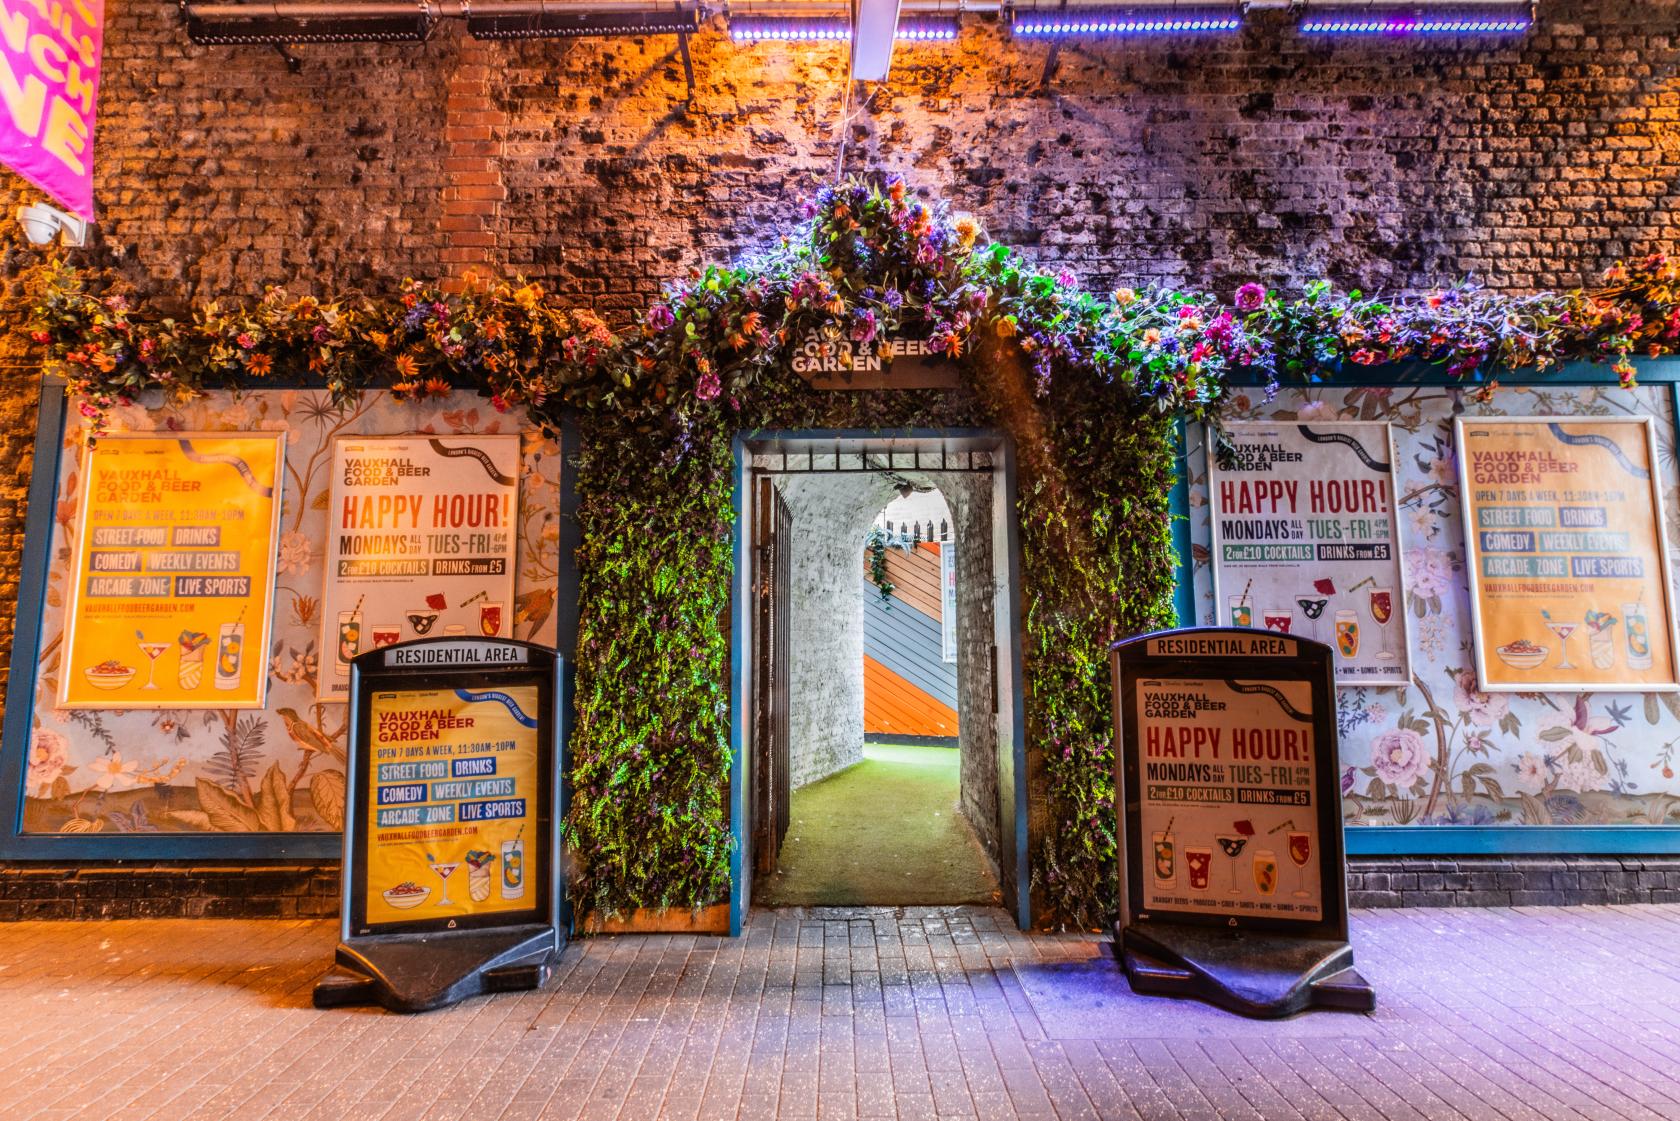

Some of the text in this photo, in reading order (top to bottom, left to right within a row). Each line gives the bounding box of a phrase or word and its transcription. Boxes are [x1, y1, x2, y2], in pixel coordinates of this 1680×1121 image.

[858, 341, 872, 356] &
[878, 340, 933, 356] EER
[791, 356, 881, 372] GAREN
[1230, 443, 1286, 453] UXHALL
[345, 458, 414, 468] VAUXHALL
[1258, 453, 1267, 462] &
[1270, 453, 1303, 462] BEER
[1473, 451, 1557, 462] VAUXHALL
[99, 470, 182, 480] VAUXHALL
[344, 467, 431, 477] FOOD & BEER
[1474, 463, 1578, 473] FOOD & BEER
[97, 481, 201, 492] FOOD & BEER
[343, 477, 399, 486] GARDEN
[1475, 474, 1541, 484] GARDEN
[96, 492, 162, 503] GARDEN
[1220, 480, 1388, 514] HAPPY HOUR!
[1475, 491, 1496, 501] OPEN
[1499, 491, 1504, 501] 7
[1506, 491, 1527, 501] DAYS
[342, 494, 509, 529] HAPPY HOUR!
[1482, 509, 1604, 526] STREET FOOD DRINKS
[95, 528, 217, 545] STREET FOOD DRINKS
[1222, 520, 1290, 540] MONDAYS
[1291, 520, 1303, 529] ALL
[1307, 519, 1372, 539] TUES-FRI
[1291, 531, 1304, 540] DAY
[340, 535, 408, 555] MONDAYS
[409, 535, 422, 544] ALL
[426, 534, 491, 554] TUES-FRI
[1485, 534, 1530, 550] COMEDY
[1543, 534, 1584, 550] WEEKLY
[409, 546, 422, 555] DAY
[1226, 546, 1233, 559] 2
[1243, 546, 1262, 560] £10
[1264, 546, 1312, 560] COCKTAILS
[1320, 545, 1354, 560] DRINKS
[1355, 550, 1373, 559] FROM
[1374, 545, 1387, 559] £5
[95, 553, 236, 570] COMEDY WEEKLY EVENTS
[341, 562, 348, 574] 2
[379, 560, 426, 575] COCKTAILS
[435, 561, 471, 574] DRINKS
[471, 564, 488, 573] FROM
[489, 560, 503, 573] £5
[1487, 558, 1642, 576] ARCADE ZONE LIVE SPORTS
[91, 578, 247, 595] ARCADE ZONE LIVE SPORTS
[1157, 639, 1287, 654] RESIDENTIAL AREA
[396, 647, 518, 664] RESIDENTIAL AREA
[1144, 692, 1210, 702] VAUXHALL
[1144, 701, 1227, 711] FOOD & BEER
[378, 709, 456, 722] VAUXHALL
[1144, 709, 1197, 719] GARDEN
[379, 718, 474, 732] FOOD & BEER
[379, 730, 440, 743] GARDEN
[1147, 727, 1309, 761] HAPPY HOUR!
[377, 741, 516, 759] OPEN 7 DAYS A WEEK, 11:30AM-10PM
[381, 759, 493, 780] STREET FOOD DRINKS
[1147, 763, 1211, 782] MONDAYS
[1212, 765, 1223, 774] ALL
[1229, 765, 1292, 785] TUES-FRI
[1212, 775, 1225, 783] DAY
[382, 779, 512, 803] COMEDY WEEKLY EVENTS
[1150, 786, 1156, 798] 2
[1166, 787, 1184, 800] £10
[1187, 788, 1232, 802] COCKTAILS
[1240, 790, 1275, 803] DRINKS
[1276, 795, 1293, 804] FROM
[1294, 791, 1307, 804] £5
[381, 801, 523, 825] ARCADE ZONE LIVE SPORTS
